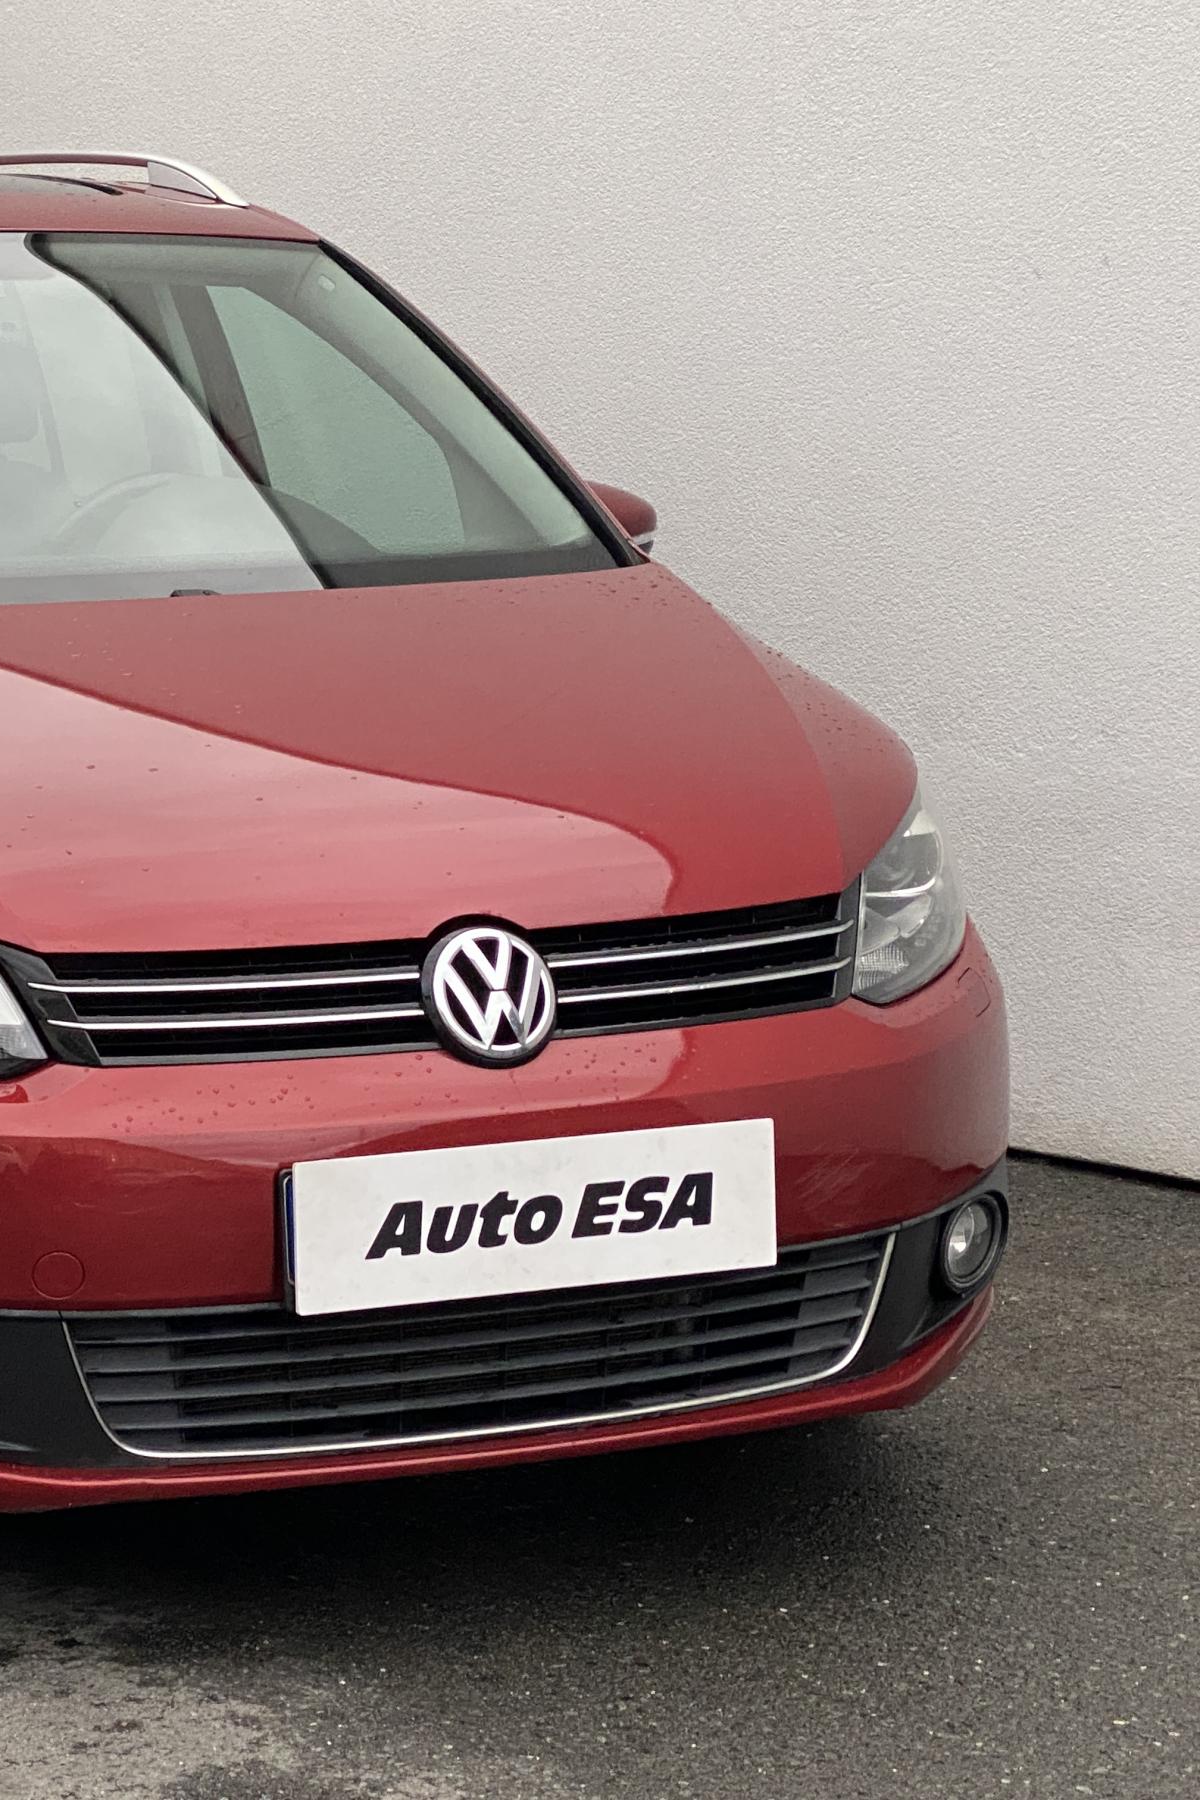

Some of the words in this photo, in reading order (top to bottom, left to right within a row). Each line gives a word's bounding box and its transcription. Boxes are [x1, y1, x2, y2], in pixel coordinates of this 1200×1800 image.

[434, 928, 555, 1056] VW
[364, 1191, 563, 1260] Auto
[571, 1172, 713, 1239] ESA
